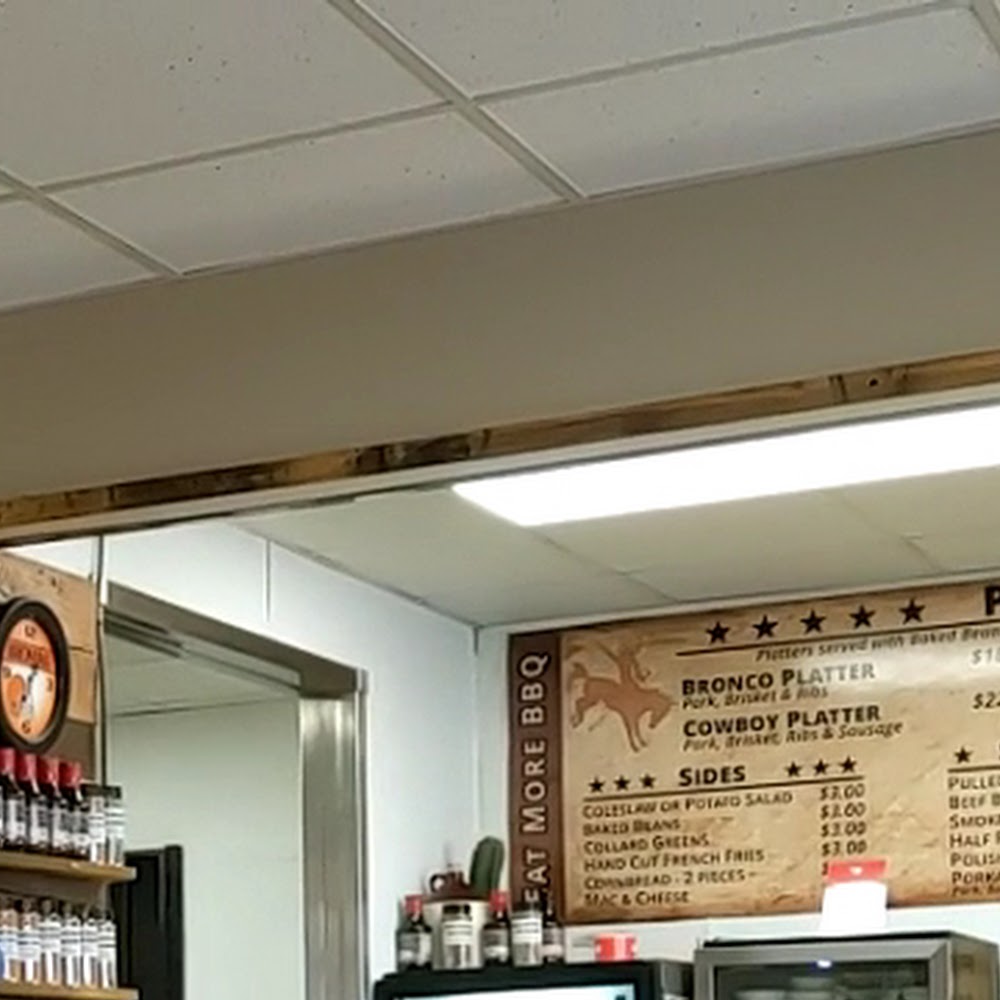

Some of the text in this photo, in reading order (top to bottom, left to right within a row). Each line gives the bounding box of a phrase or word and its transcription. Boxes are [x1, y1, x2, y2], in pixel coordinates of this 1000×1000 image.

[755, 645, 814, 661] Platters
[521, 653, 548, 724] BBQ
[682, 663, 876, 695] BRONCO PLATTER
[683, 704, 880, 737] COWBOY PLATTER
[838, 721, 903, 739] Sausage
[522, 740, 546, 833] MORE
[678, 765, 746, 787] SIDES
[582, 802, 657, 819] COLESLAW
[685, 796, 741, 810] POTATO
[745, 791, 793, 807] SALAD
[949, 794, 986, 810] BEEF
[582, 819, 681, 836] BAKED BEANS
[583, 834, 710, 855] COLLARD GREENS
[950, 831, 991, 848] HALF
[584, 848, 765, 872] HAND CUT FRENCH FRIES
[584, 874, 672, 890] CORNBREAD
[683, 870, 694, 885] 2
[697, 868, 746, 884] PIECES
[635, 890, 690, 906] CHEESE
